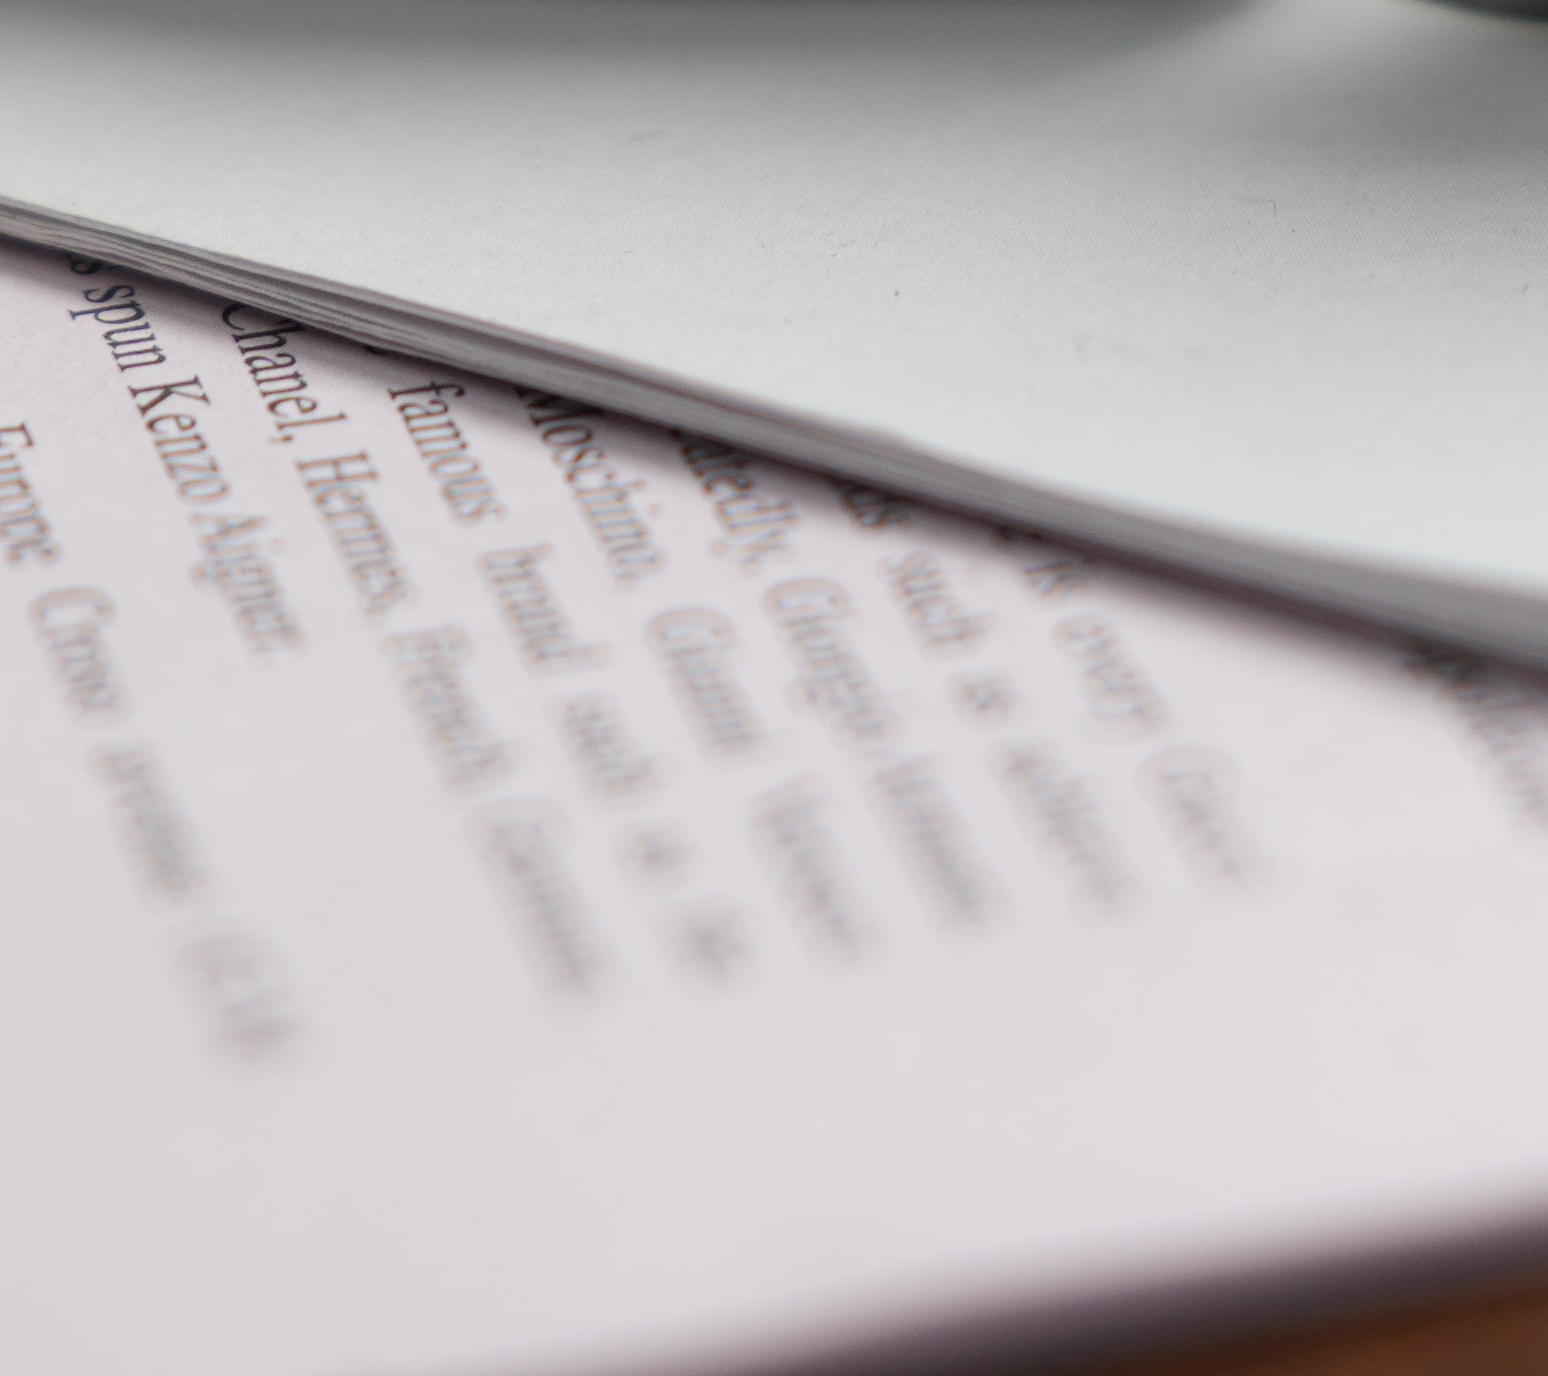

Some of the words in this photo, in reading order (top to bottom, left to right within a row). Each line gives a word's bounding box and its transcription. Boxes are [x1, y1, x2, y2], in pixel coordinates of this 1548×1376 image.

[68, 277, 168, 376] spun
[127, 372, 234, 508] Kenzo
[386, 378, 504, 526] famous
